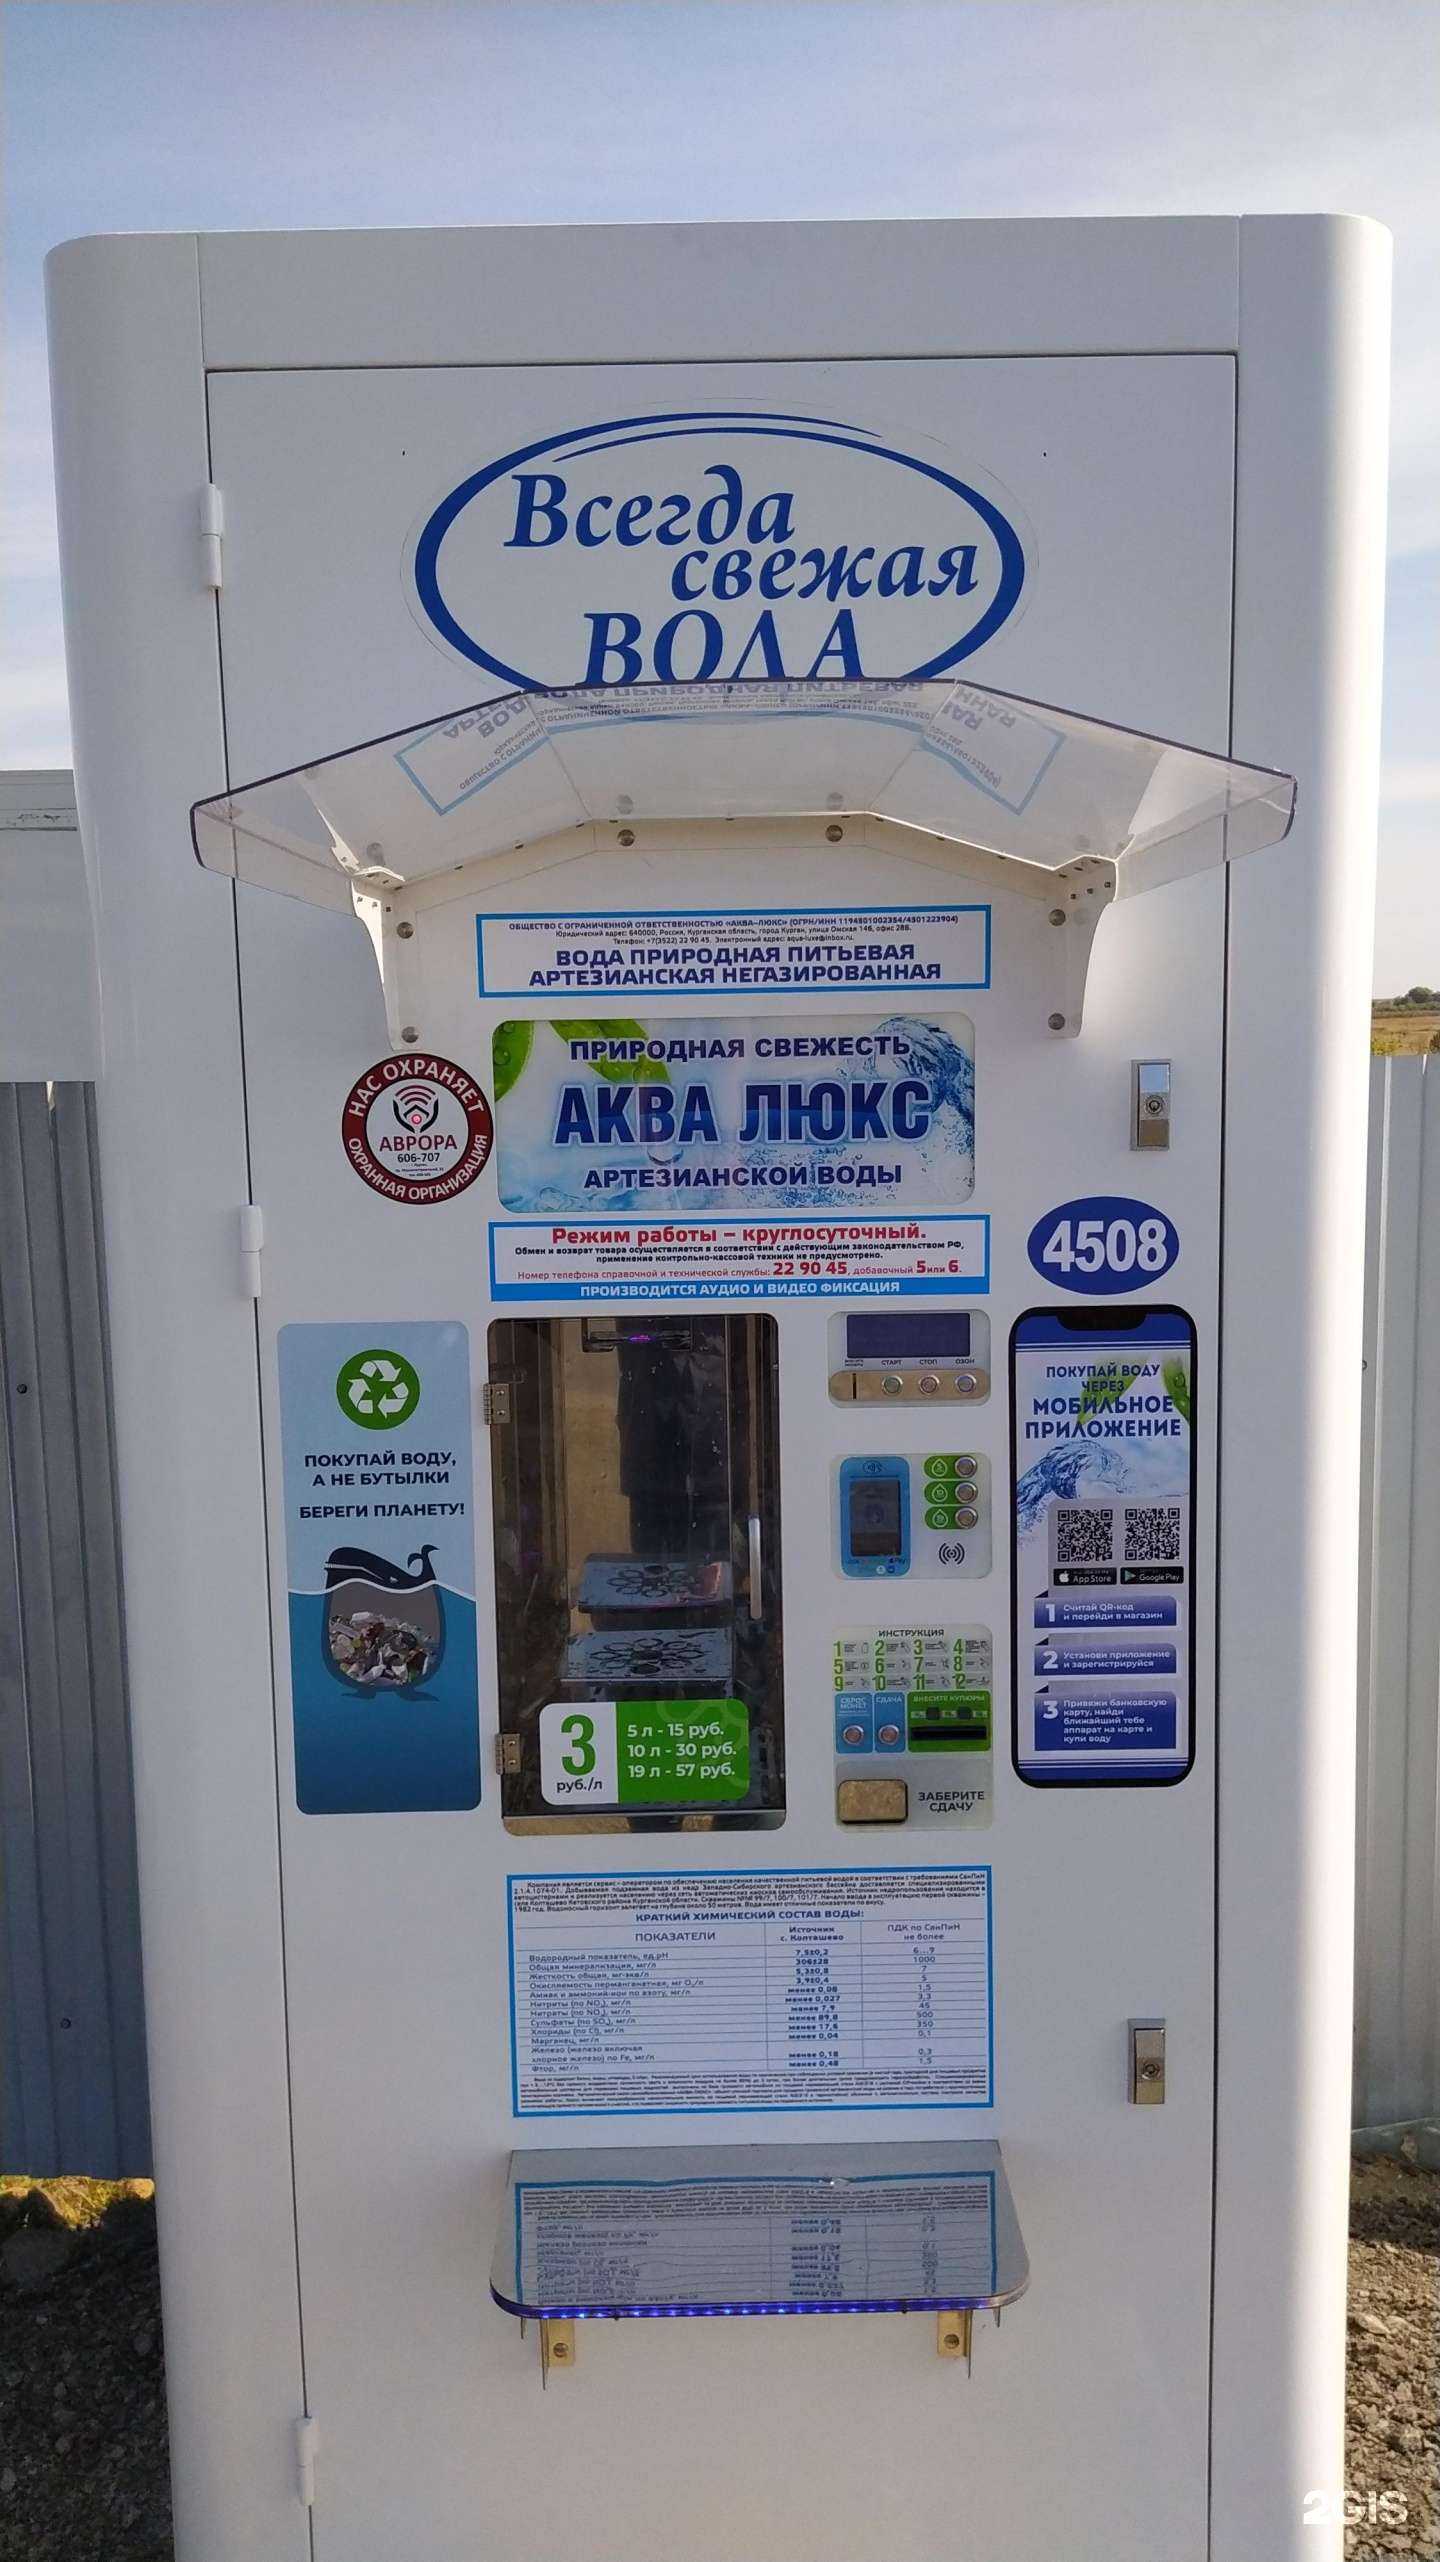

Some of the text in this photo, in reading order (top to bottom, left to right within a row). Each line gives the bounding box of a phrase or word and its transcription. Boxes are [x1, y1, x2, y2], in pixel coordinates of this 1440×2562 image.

[504, 464, 796, 548] Всегда
[671, 545, 980, 602] свежая
[509, 923, 556, 931] ОБЩЕСТВО
[564, 921, 632, 929] ОГРАНИЧЕННОЙ
[556, 944, 914, 968] ВОДА ПРИРОДНАЯ ПИТЬЕВАЯ
[529, 964, 941, 986] АРТЕЗИАНСКАЯ НЕГАЗИРОВАННАЯ
[570, 1035, 911, 1063] ПРИРОДНАЯ СВЕЖЕСТЬ
[349, 1059, 484, 1118] НАС ОХРАНЯЕТ
[554, 1080, 933, 1145] АКВА ЛЮКС
[379, 1135, 458, 1152] АВРОРА
[398, 1153, 440, 1163] 606-707
[349, 1134, 488, 1200] ОХРАННАЯ ОРГАНИЗАЦИЯ
[584, 1164, 902, 1189] АРТЕЗИАНСКОЙ ВОДЫ
[552, 1223, 926, 1247] Режим работы круглосуточный.
[515, 1247, 545, 1255] Обмен
[629, 1246, 703, 1254] осуществляется
[852, 1242, 944, 1250] законодательством
[1043, 1218, 1168, 1272] 4508
[597, 1256, 653, 1264] применение
[655, 1253, 755, 1262] контрольно-кассовой
[810, 1252, 883, 1260] предусмотрено.
[518, 1271, 549, 1280] Номер
[552, 1270, 598, 1280] телефона
[601, 1270, 657, 1279] справочной
[668, 1268, 728, 1278] технической
[731, 1268, 770, 1278] службы:
[773, 1262, 794, 1275] 22
[800, 1262, 821, 1275] 90
[853, 1265, 913, 1275] добавочный
[916, 1260, 926, 1273] 5
[580, 1281, 900, 1297] ПРОИЗВОДИТСЯ АУДИО И ВИДЕО ФИКСАЦИЯ
[1046, 1362, 1160, 1378] ПОКУПАЙ ВОДУ
[1081, 1380, 1124, 1393] ЧЕРЕЗ
[1033, 1395, 1173, 1416] МОБИЛЬНОЕ
[1025, 1418, 1181, 1439] ПРИЛОЖЕНИЕ
[304, 1450, 457, 1469] ПОКУПАЙ ВОДУ,
[312, 1470, 450, 1487] А НЕ БУТЫЛКИ
[299, 1501, 465, 1520] БЕРЕГИ ПЛАНЕТУ!
[1140, 1573, 1180, 1582] Google Play
[1046, 1604, 1055, 1622] 1
[1064, 1603, 1134, 1612] Считай QR-код
[1072, 1612, 1114, 1621] перейди
[879, 1629, 945, 1638] ИНСТРУКЦИЯ
[834, 1641, 842, 1656] 1
[874, 1640, 885, 1656] 2
[913, 1639, 923, 1655] 3
[953, 1639, 964, 1654] 4
[954, 1656, 963, 1671] 8
[1043, 1651, 1058, 1669] 2
[1109, 1652, 1170, 1660] приложение
[834, 1659, 844, 1674] 5
[875, 1658, 884, 1673] 6
[914, 1657, 923, 1672] 7
[1072, 1660, 1154, 1669] зарегистрируйся
[834, 1676, 843, 1691] 9
[872, 1676, 885, 1691] 10
[913, 1674, 925, 1690] 11
[953, 1673, 966, 1689] 12
[1043, 1700, 1058, 1719] 3
[1064, 1699, 1167, 1708] Привяжи банковскую
[1064, 1708, 1124, 1717] карту, найди
[1064, 1717, 1120, 1725] ближайший
[627, 1722, 724, 1739] 5 л 15 руб.
[560, 1714, 597, 1776] 3
[1089, 1736, 1111, 1744] воду
[627, 1743, 737, 1759] 10 л 30 руб.
[628, 1763, 736, 1779] 19 л 57 руб.
[556, 1778, 603, 1793] руб./л
[918, 1791, 985, 1800] ЗАБЕРИТЕ
[930, 1802, 973, 1813] СДАЧУ
[636, 1910, 864, 1921] КРАТКИЙ ХИМИЧЕСКИЙ СОСТАВ ВОДЫ:
[635, 1932, 715, 1941] ПОКАЗАТЕЛИ
[529, 1954, 586, 1962] Водородный
